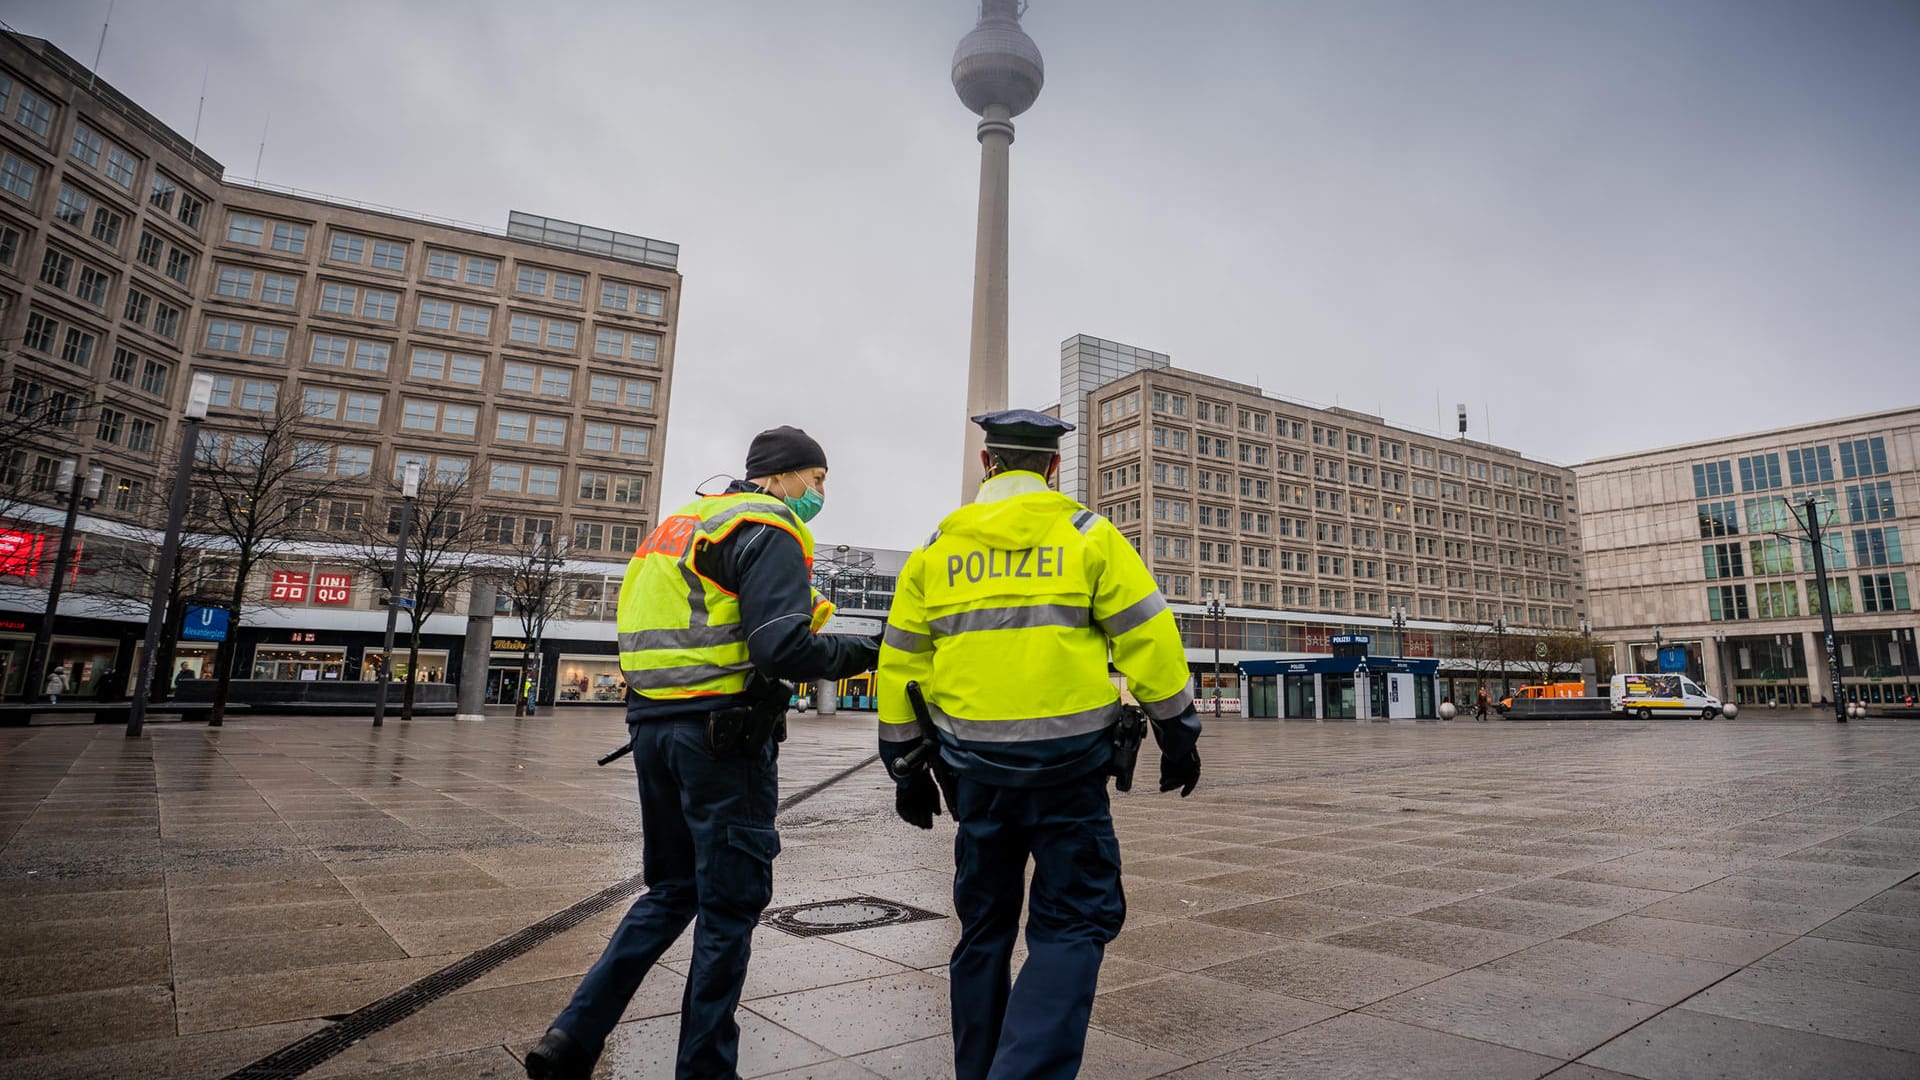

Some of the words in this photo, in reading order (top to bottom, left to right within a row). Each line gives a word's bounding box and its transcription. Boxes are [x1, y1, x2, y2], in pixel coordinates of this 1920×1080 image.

[947, 546, 1064, 588] POLIZEI
[320, 577, 346, 587] UNI
[318, 589, 346, 602] QLO
[202, 609, 213, 626] U
[1306, 634, 1331, 647] SALE
[1409, 640, 1430, 651] SALE
